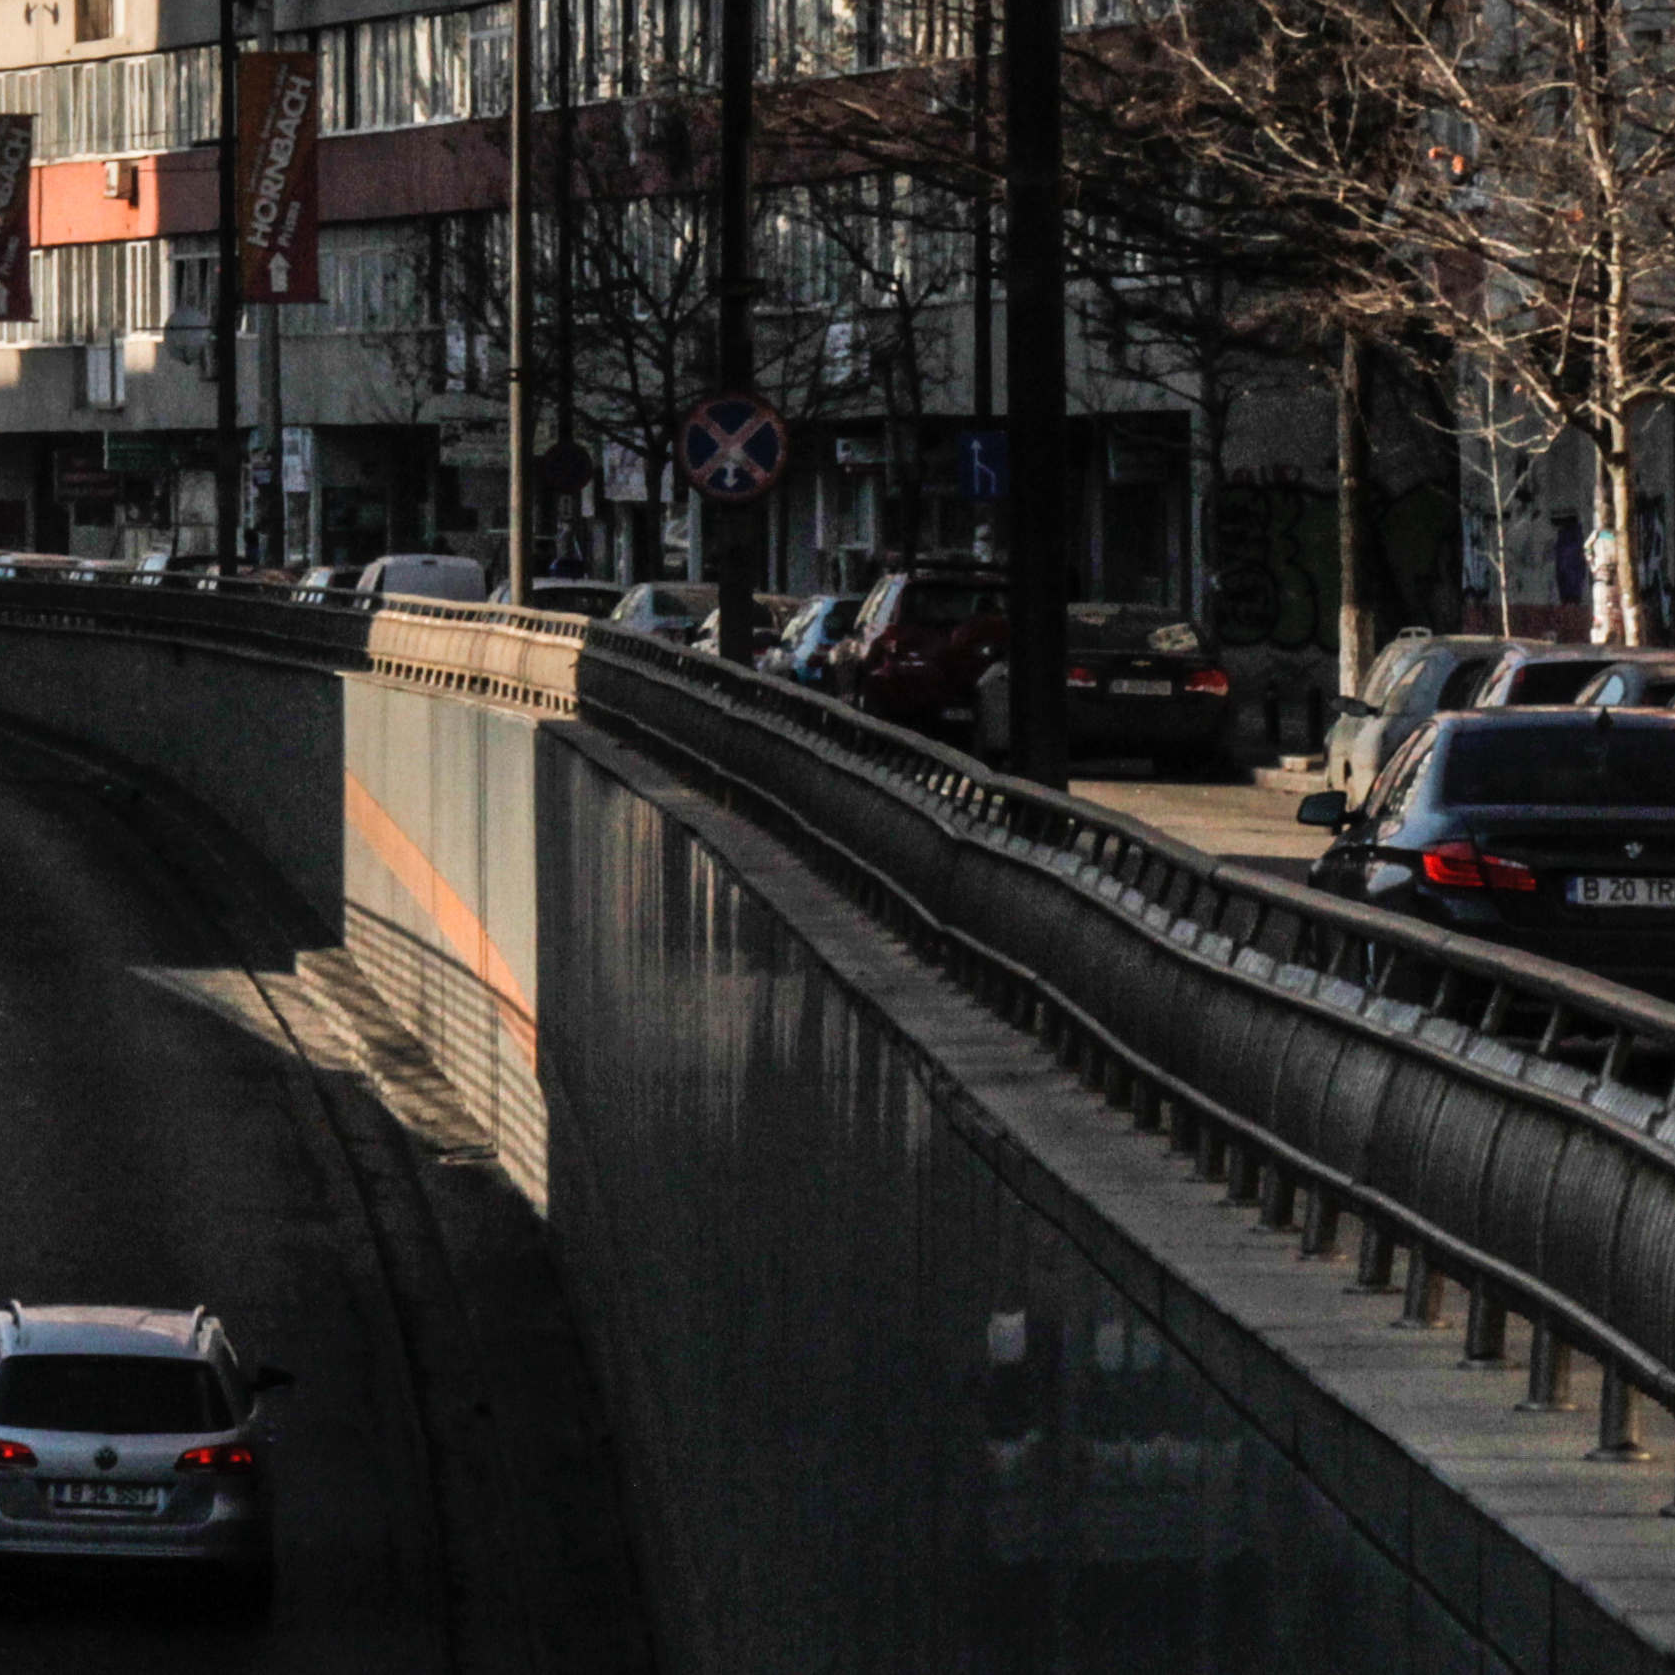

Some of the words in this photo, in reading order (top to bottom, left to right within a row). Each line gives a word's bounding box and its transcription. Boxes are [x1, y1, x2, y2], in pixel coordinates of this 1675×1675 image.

[247, 75, 312, 248] HORNBACH
[1583, 878, 1599, 901] B
[1610, 878, 1636, 901] 20
